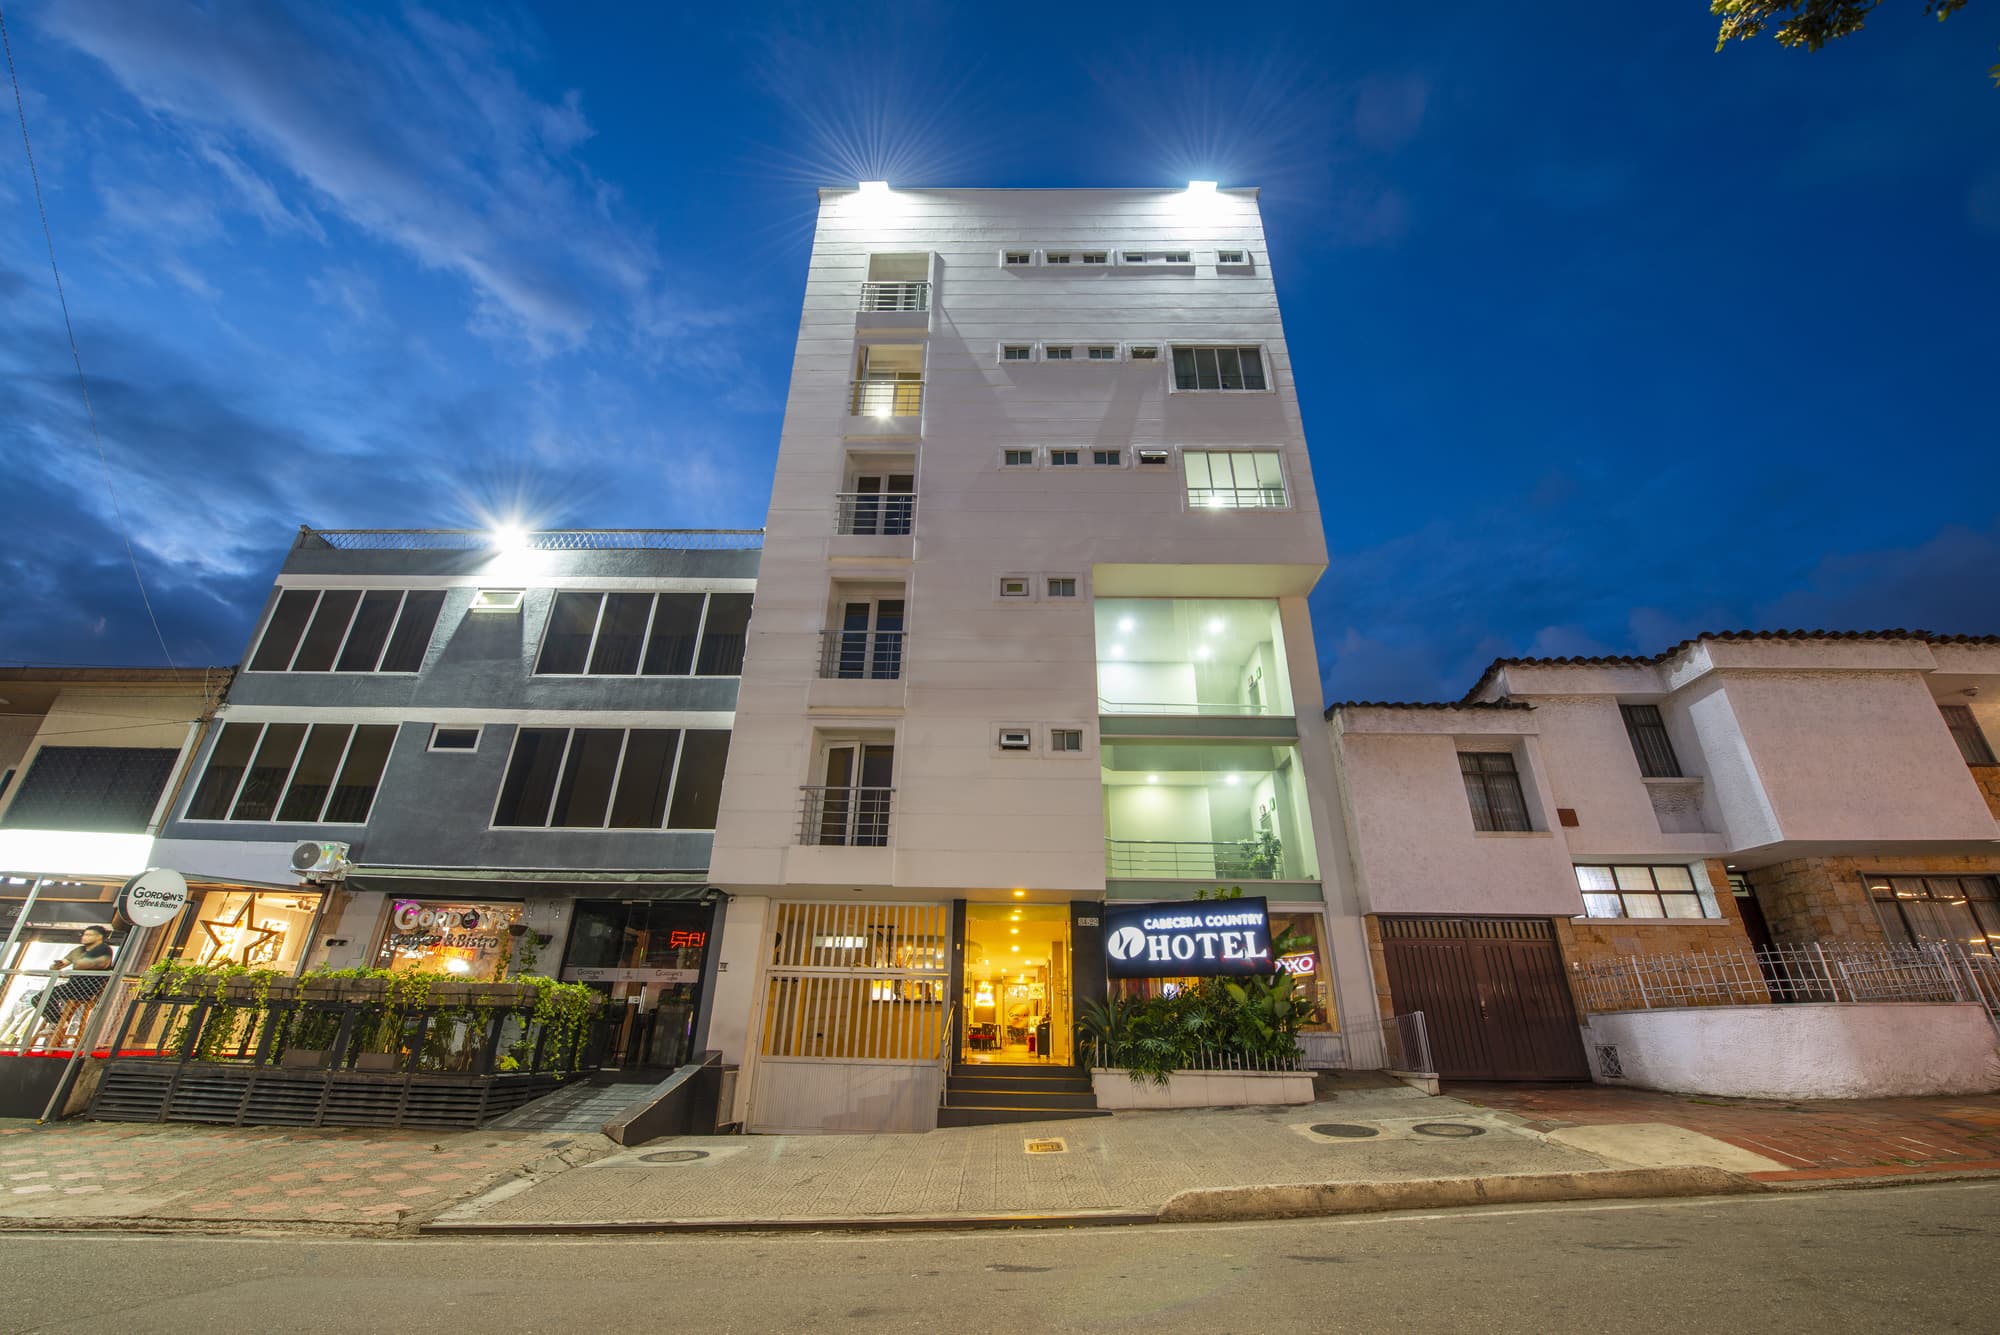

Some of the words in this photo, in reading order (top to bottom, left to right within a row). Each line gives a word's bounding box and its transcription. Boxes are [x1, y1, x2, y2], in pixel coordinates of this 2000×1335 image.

[133, 886, 184, 902] GORDON'S
[1143, 915, 1202, 930] CABECERA
[1205, 913, 1263, 927] COUNTRY
[458, 933, 498, 948] Bistro
[1146, 931, 1268, 961] HOTEL
